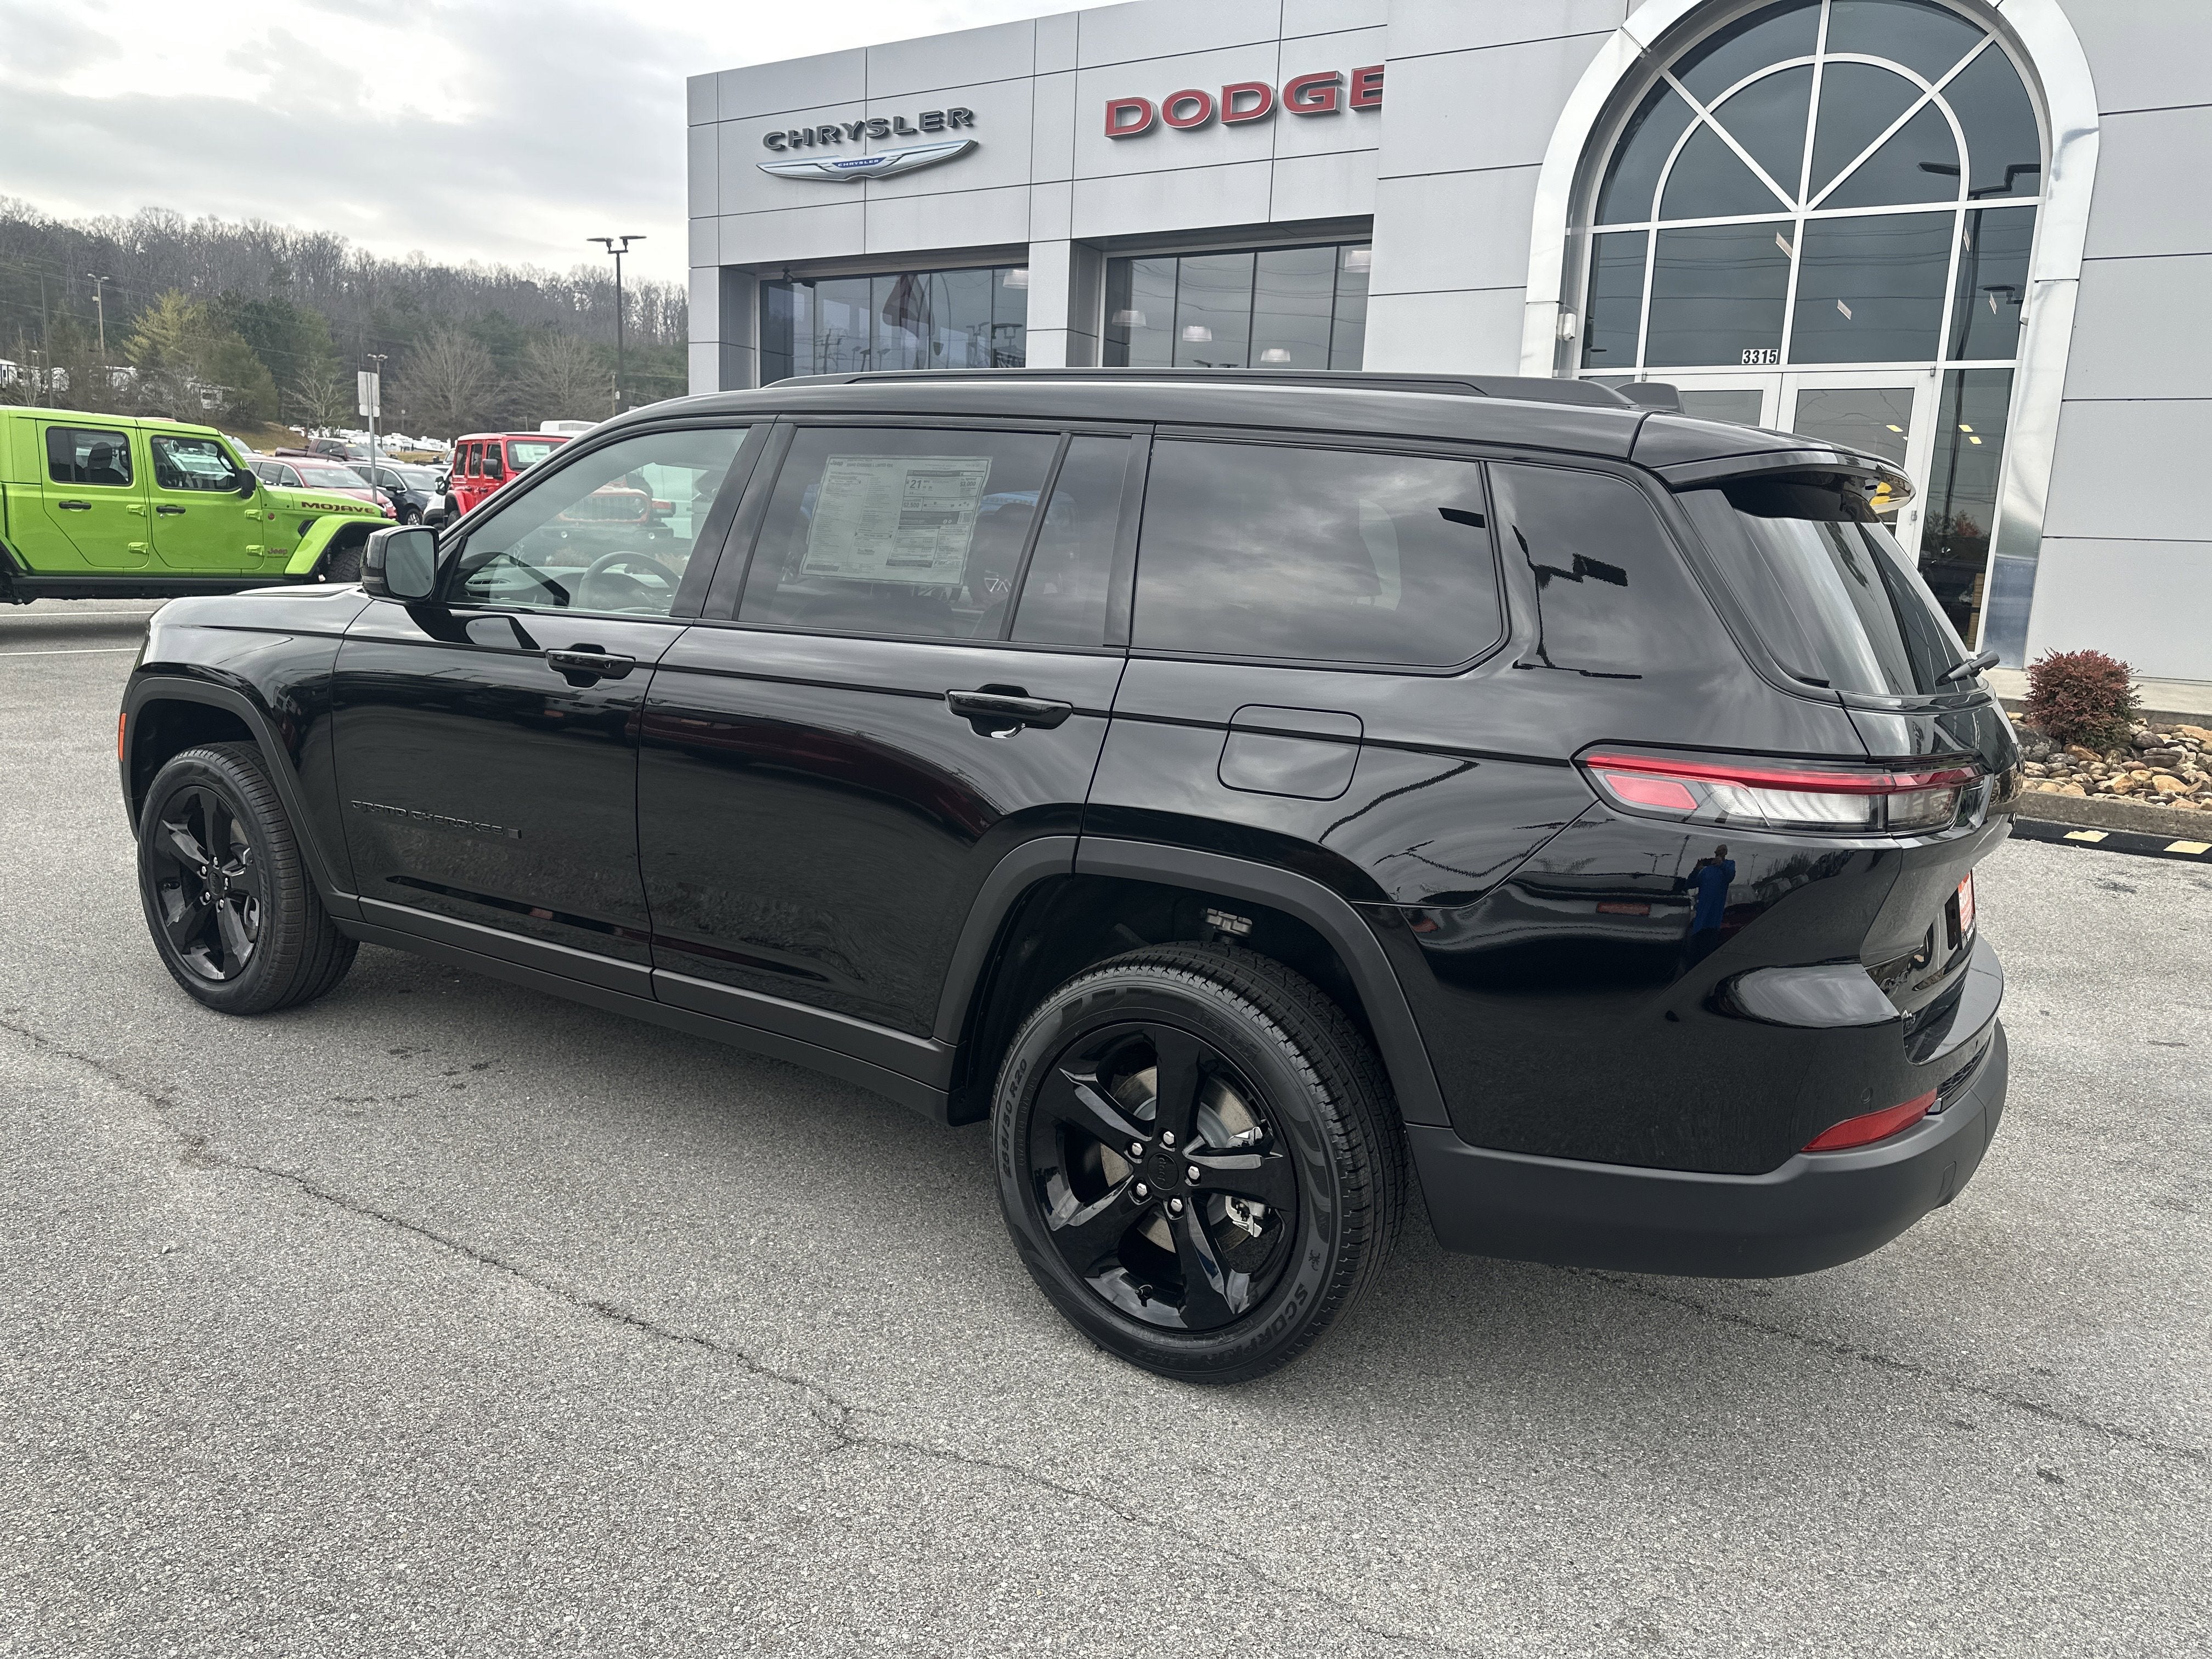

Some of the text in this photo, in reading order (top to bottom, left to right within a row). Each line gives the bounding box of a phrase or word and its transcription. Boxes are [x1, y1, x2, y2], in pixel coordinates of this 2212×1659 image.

[1104, 64, 1385, 139] DODGE
[762, 107, 973, 150] CHRYSLER
[1743, 349, 1777, 364] 3315
[910, 479, 922, 489] 21
[301, 501, 375, 514] MOJAVE
[267, 548, 288, 556] Jeep
[1002, 1058, 1028, 1178] 265/50 R20
[1200, 1283, 1309, 1365] SCORPION
